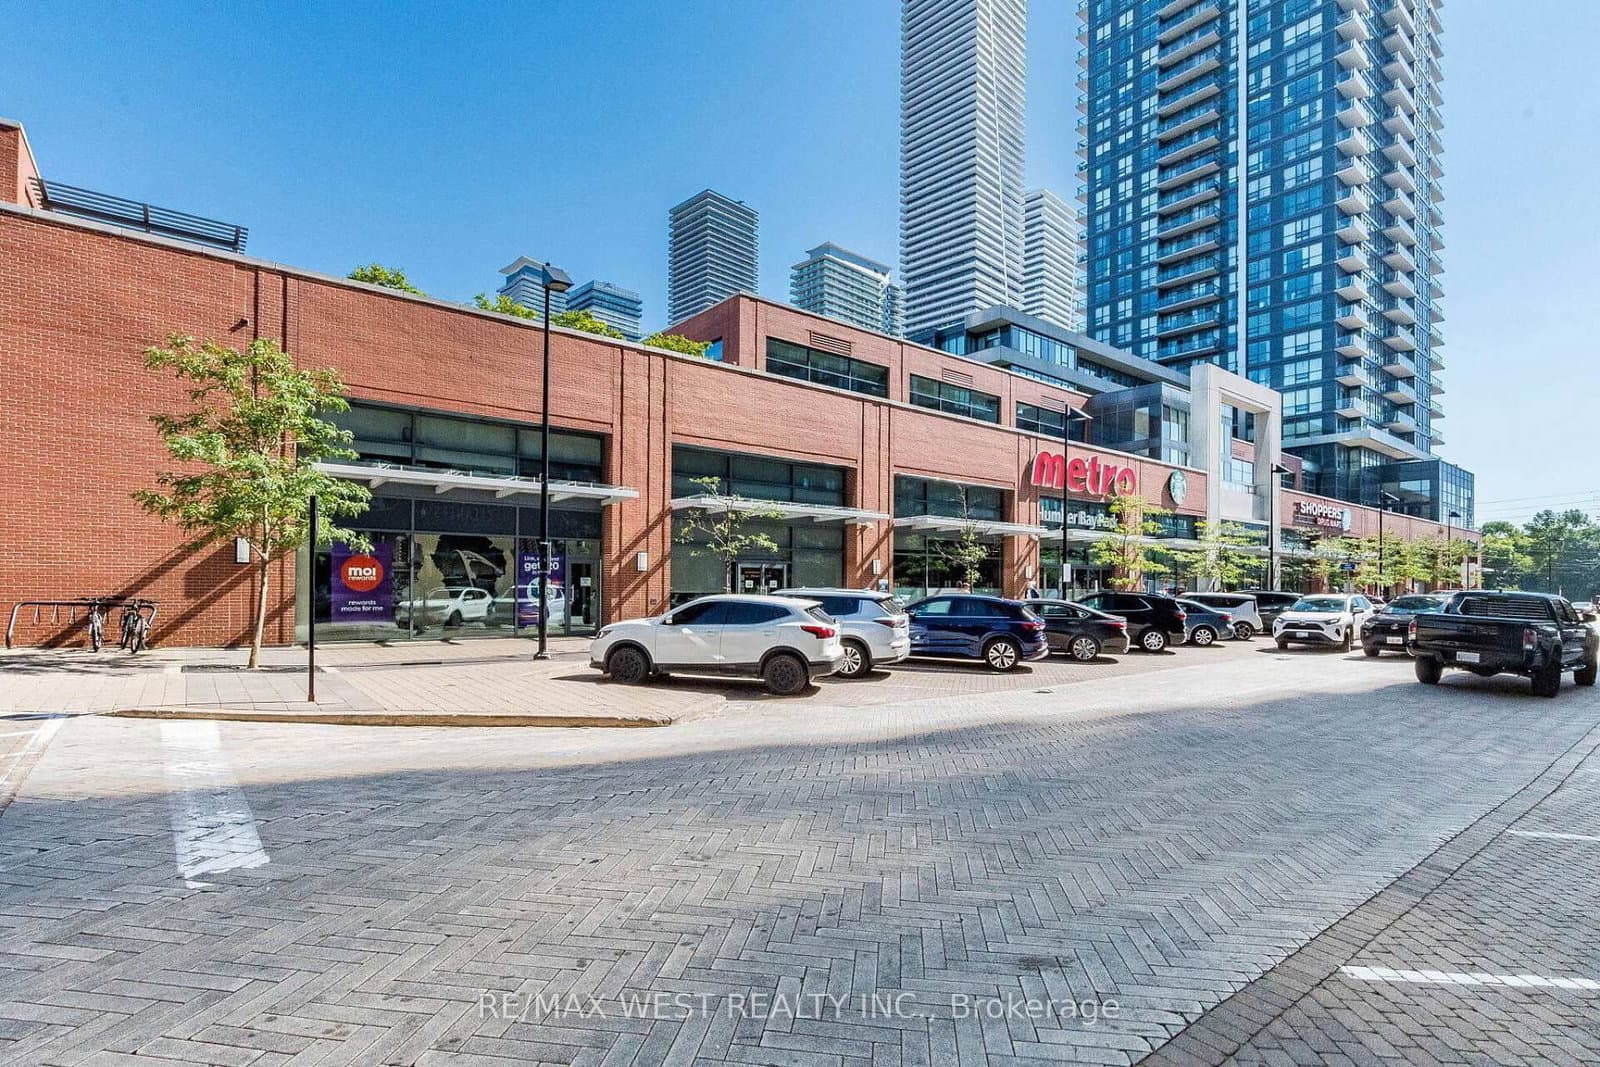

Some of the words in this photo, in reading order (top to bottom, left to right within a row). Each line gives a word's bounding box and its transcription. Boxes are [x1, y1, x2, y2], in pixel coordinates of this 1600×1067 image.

[1031, 451, 1136, 496] metro
[1300, 501, 1342, 519] SHOPPERS
[1079, 511, 1097, 529] Bay
[348, 567, 376, 576] moi
